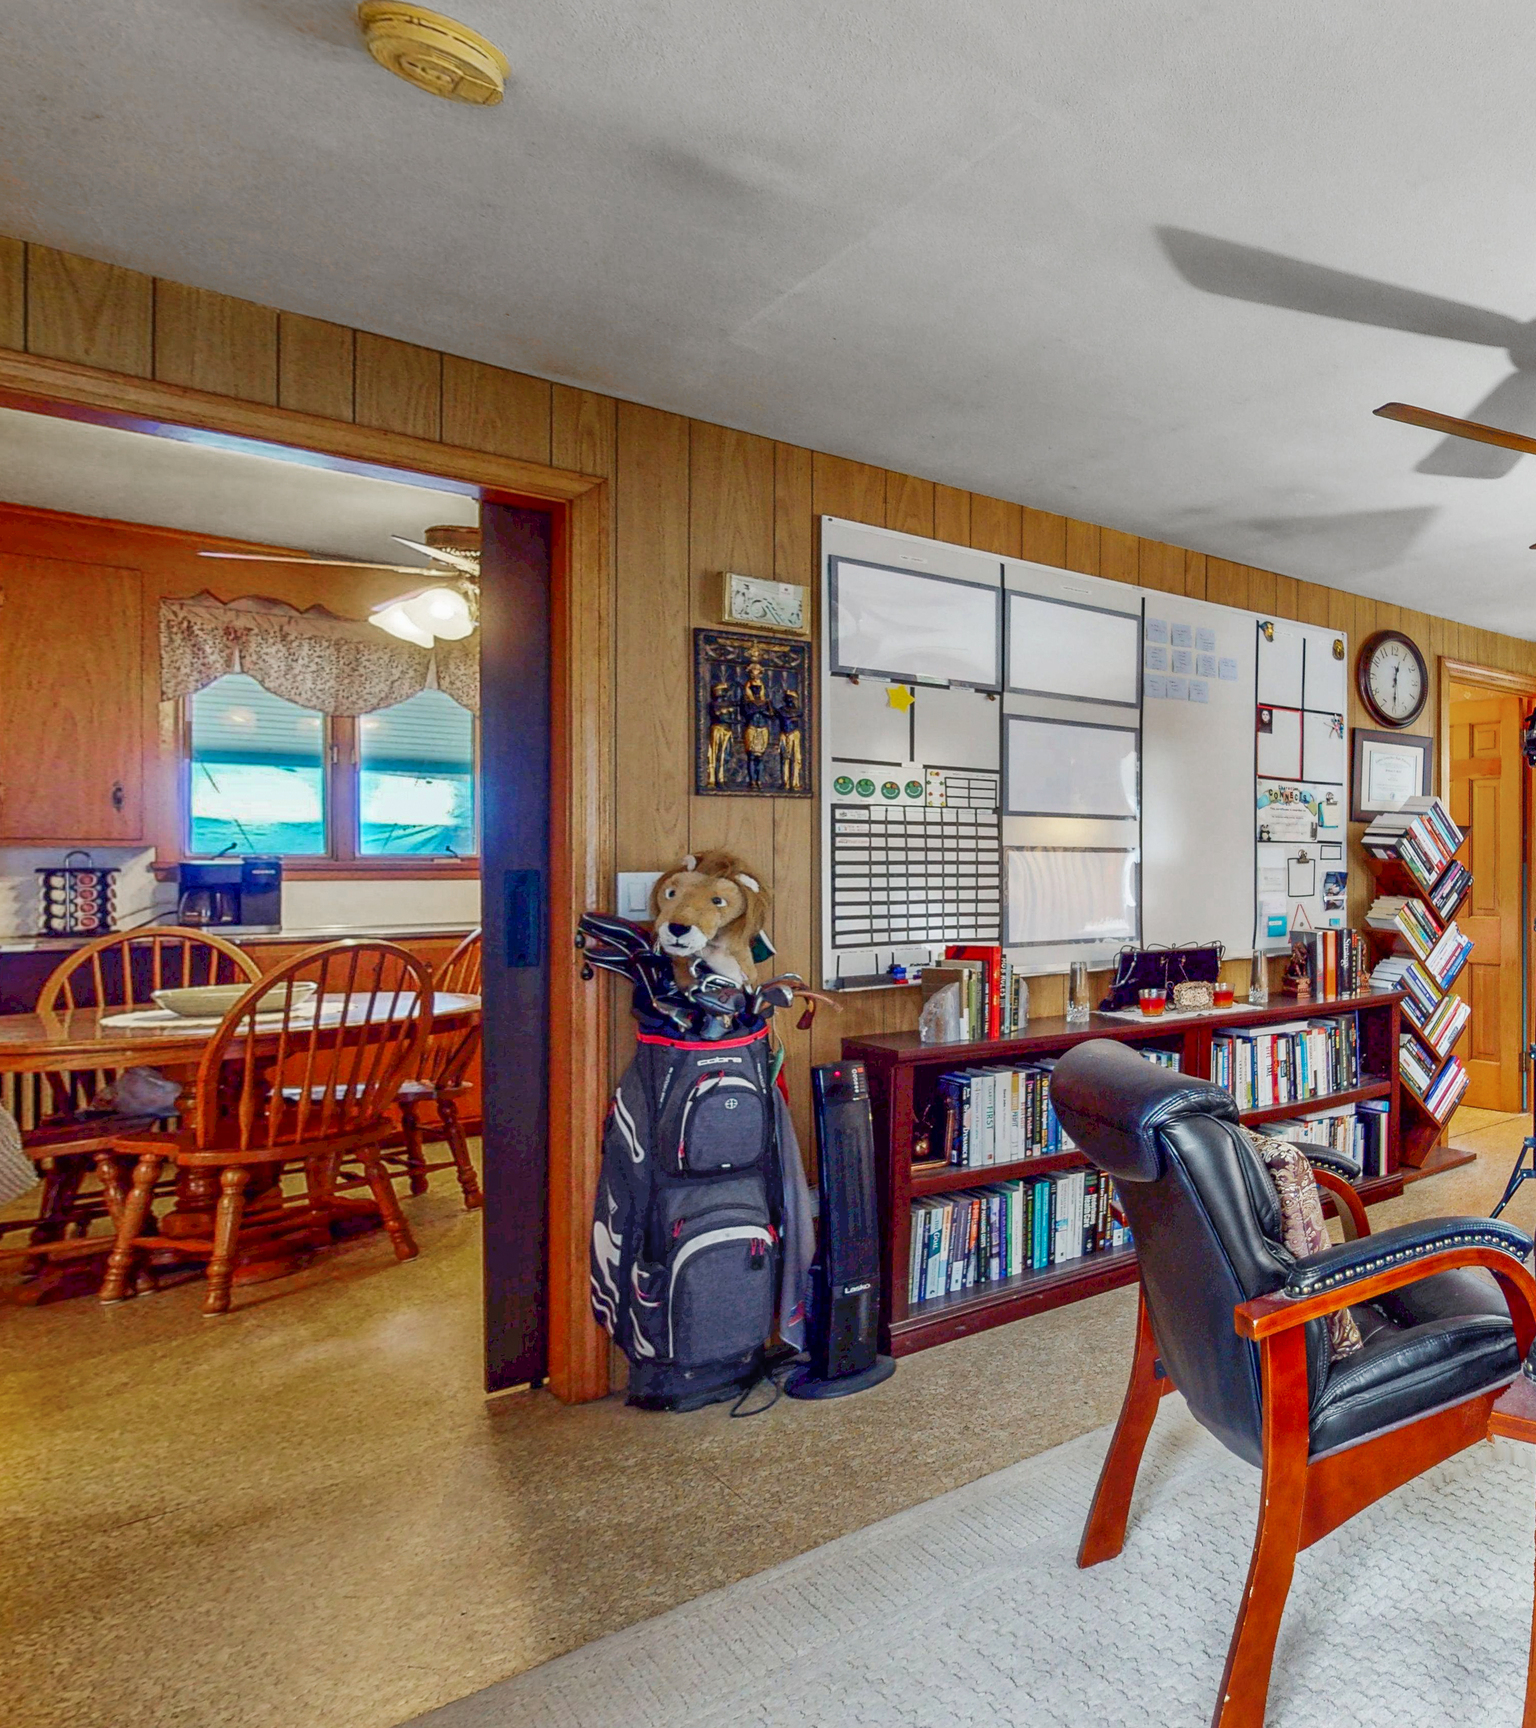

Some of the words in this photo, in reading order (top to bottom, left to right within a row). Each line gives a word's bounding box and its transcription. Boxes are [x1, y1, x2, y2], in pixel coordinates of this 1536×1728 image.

[1380, 647, 1388, 659] 11
[1391, 645, 1399, 656] 12
[1372, 655, 1381, 668] 10
[1408, 664, 1416, 674] 2
[1370, 672, 1377, 681] 9
[1341, 938, 1351, 968] Strategy
[697, 1056, 742, 1067] cobra
[932, 1232, 940, 1250] GOAL
[844, 1283, 871, 1294] Lasko
